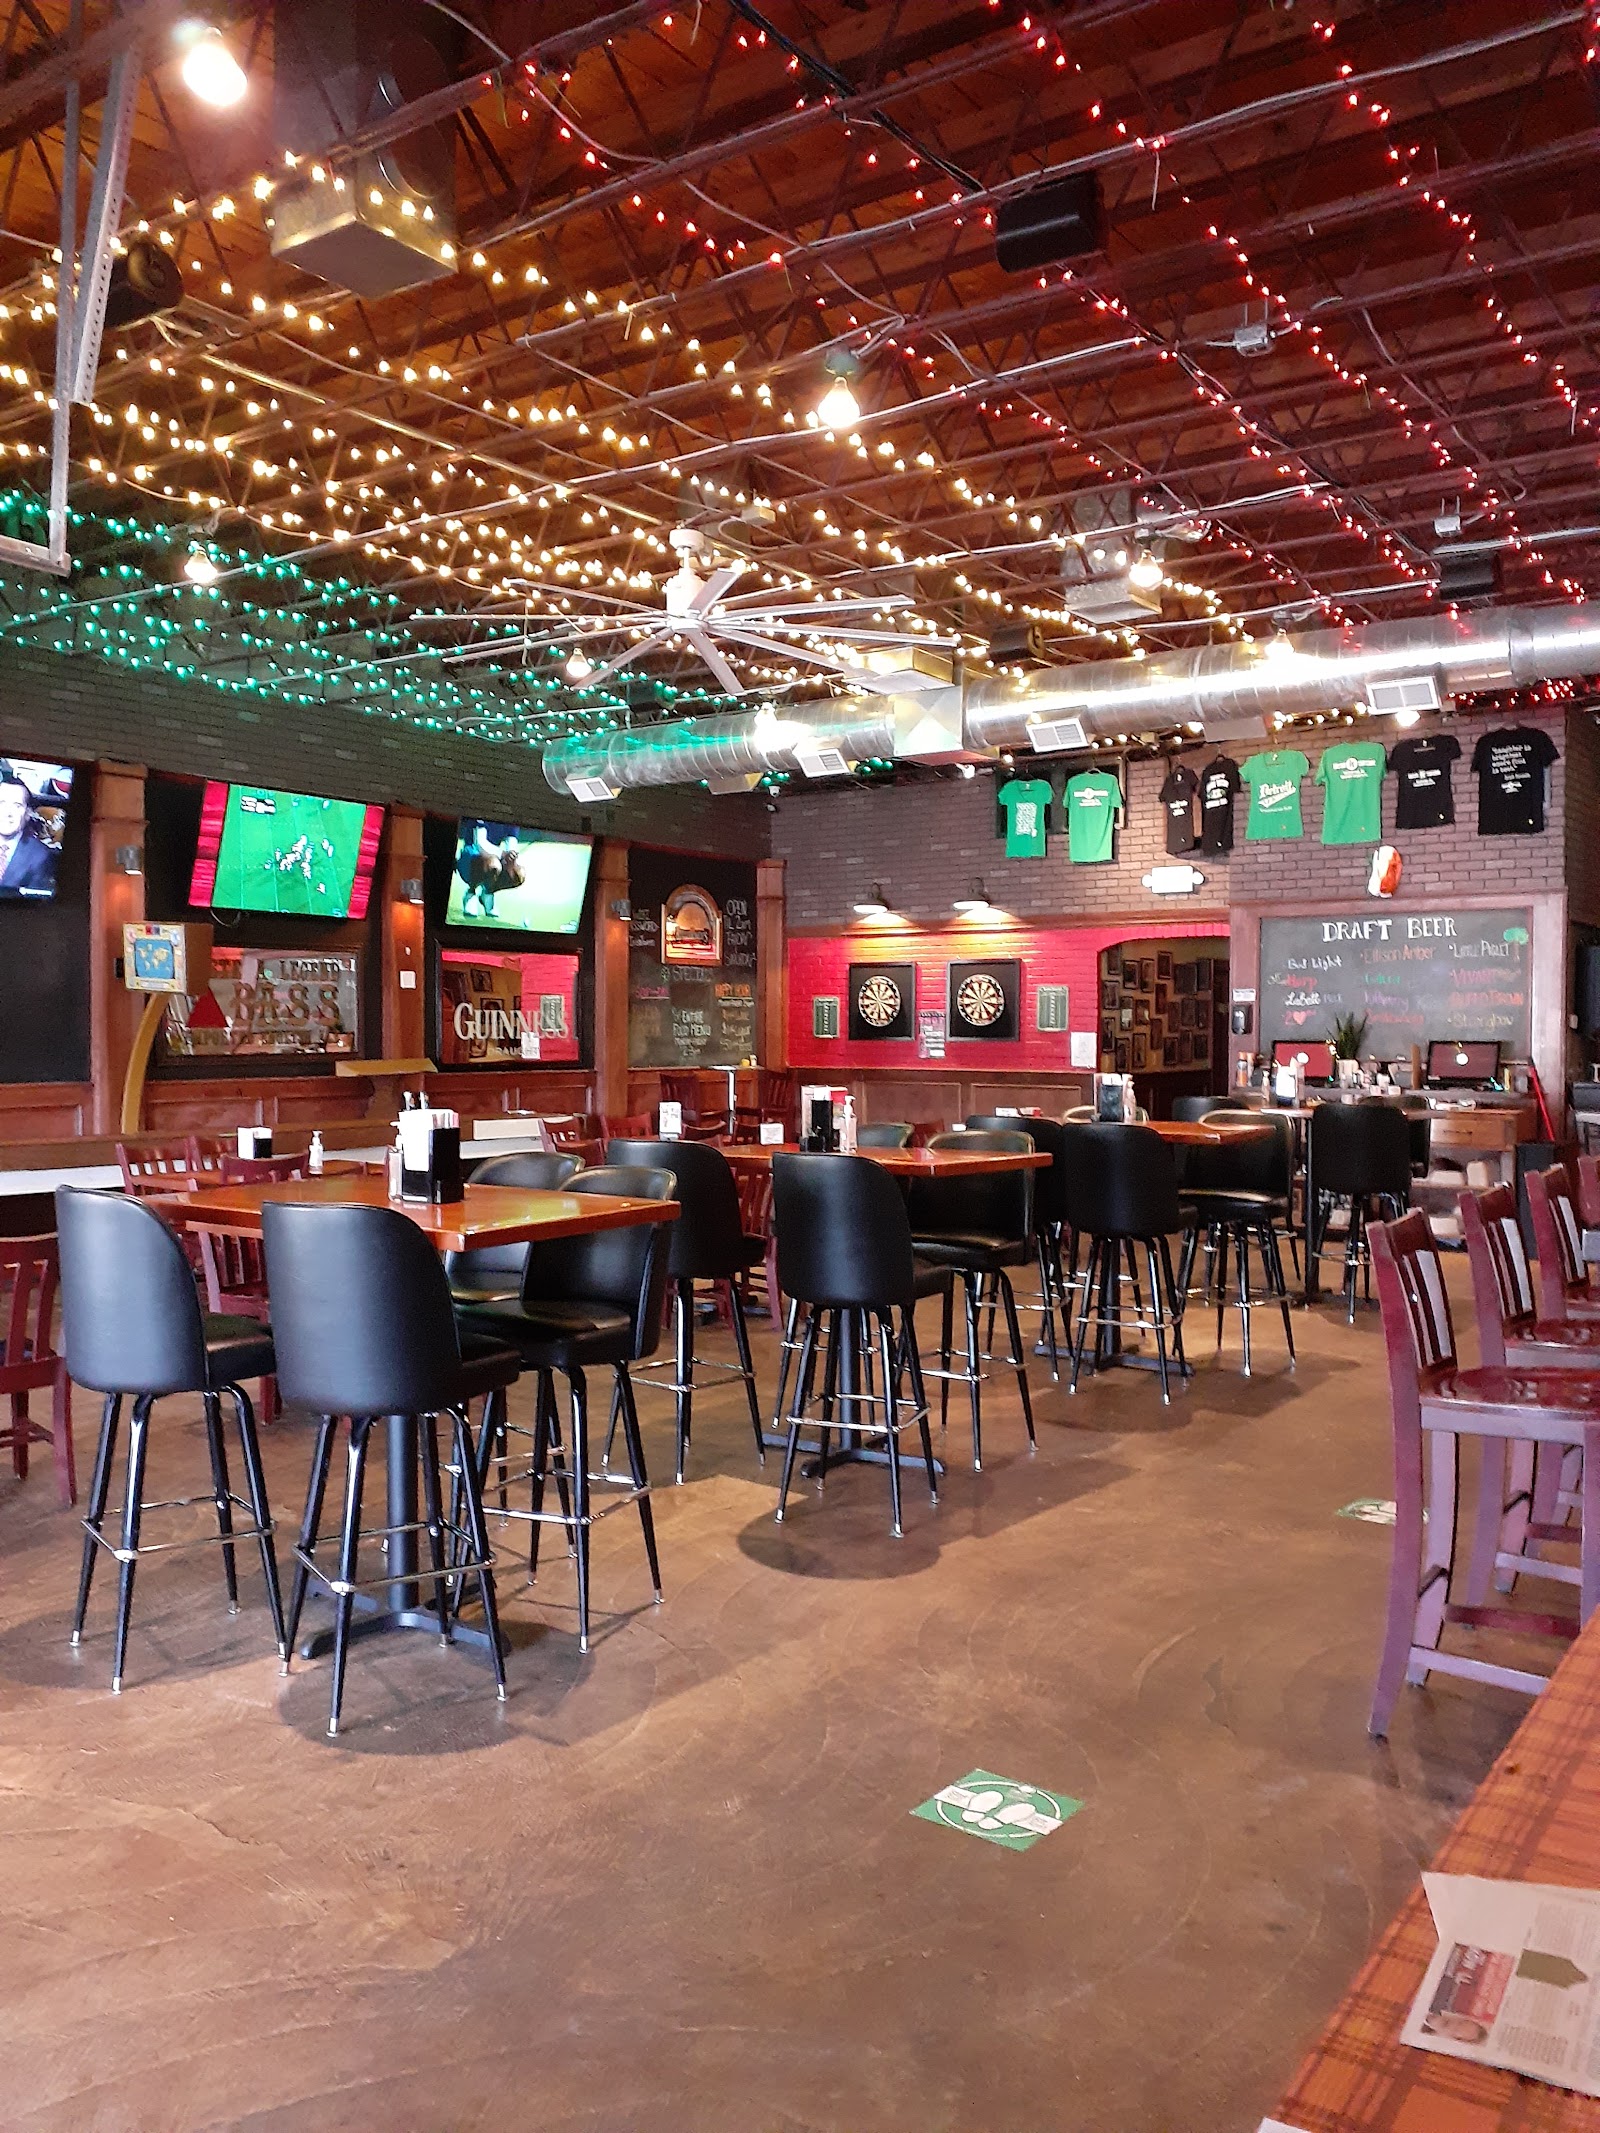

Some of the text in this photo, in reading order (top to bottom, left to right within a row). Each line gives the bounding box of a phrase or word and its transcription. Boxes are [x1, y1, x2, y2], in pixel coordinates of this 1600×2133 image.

[1322, 917, 1457, 942] DRAFT BEER
[1312, 955, 1342, 972] Light
[453, 1002, 568, 1041] GUINNESS
